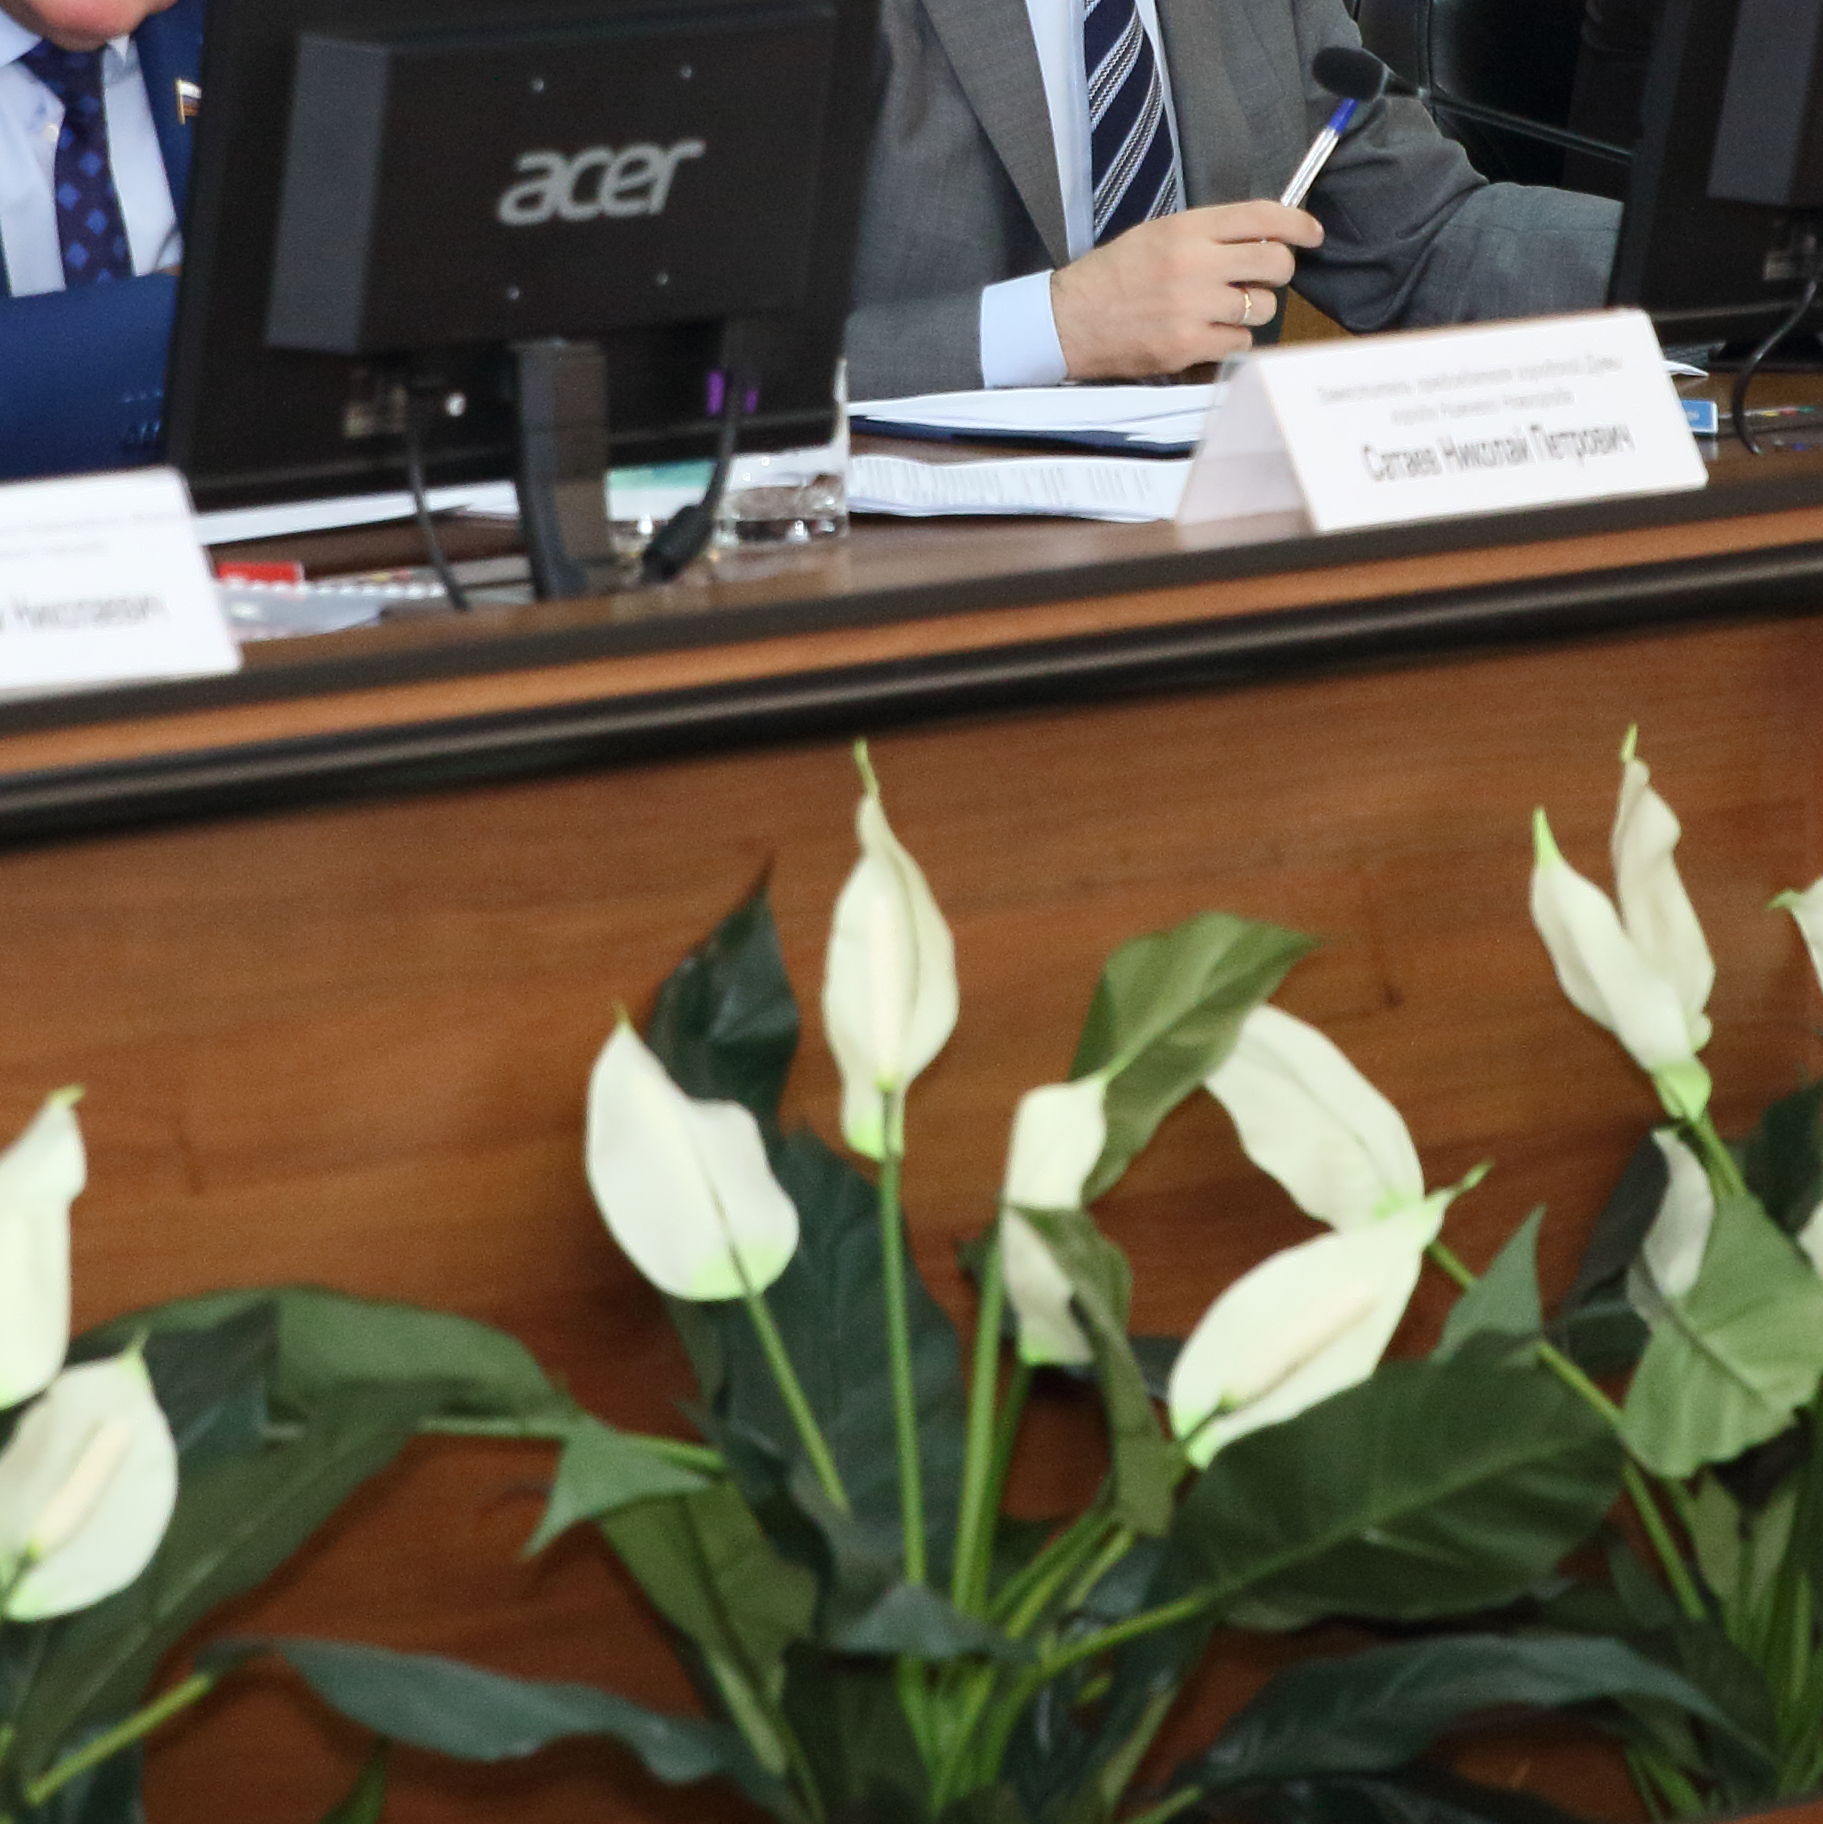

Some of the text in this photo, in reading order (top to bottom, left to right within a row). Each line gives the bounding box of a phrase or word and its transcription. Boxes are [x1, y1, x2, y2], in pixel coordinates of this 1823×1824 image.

[497, 139, 707, 226] acer
[1436, 425, 1530, 475] Николай
[1527, 422, 1638, 469] Петрович
